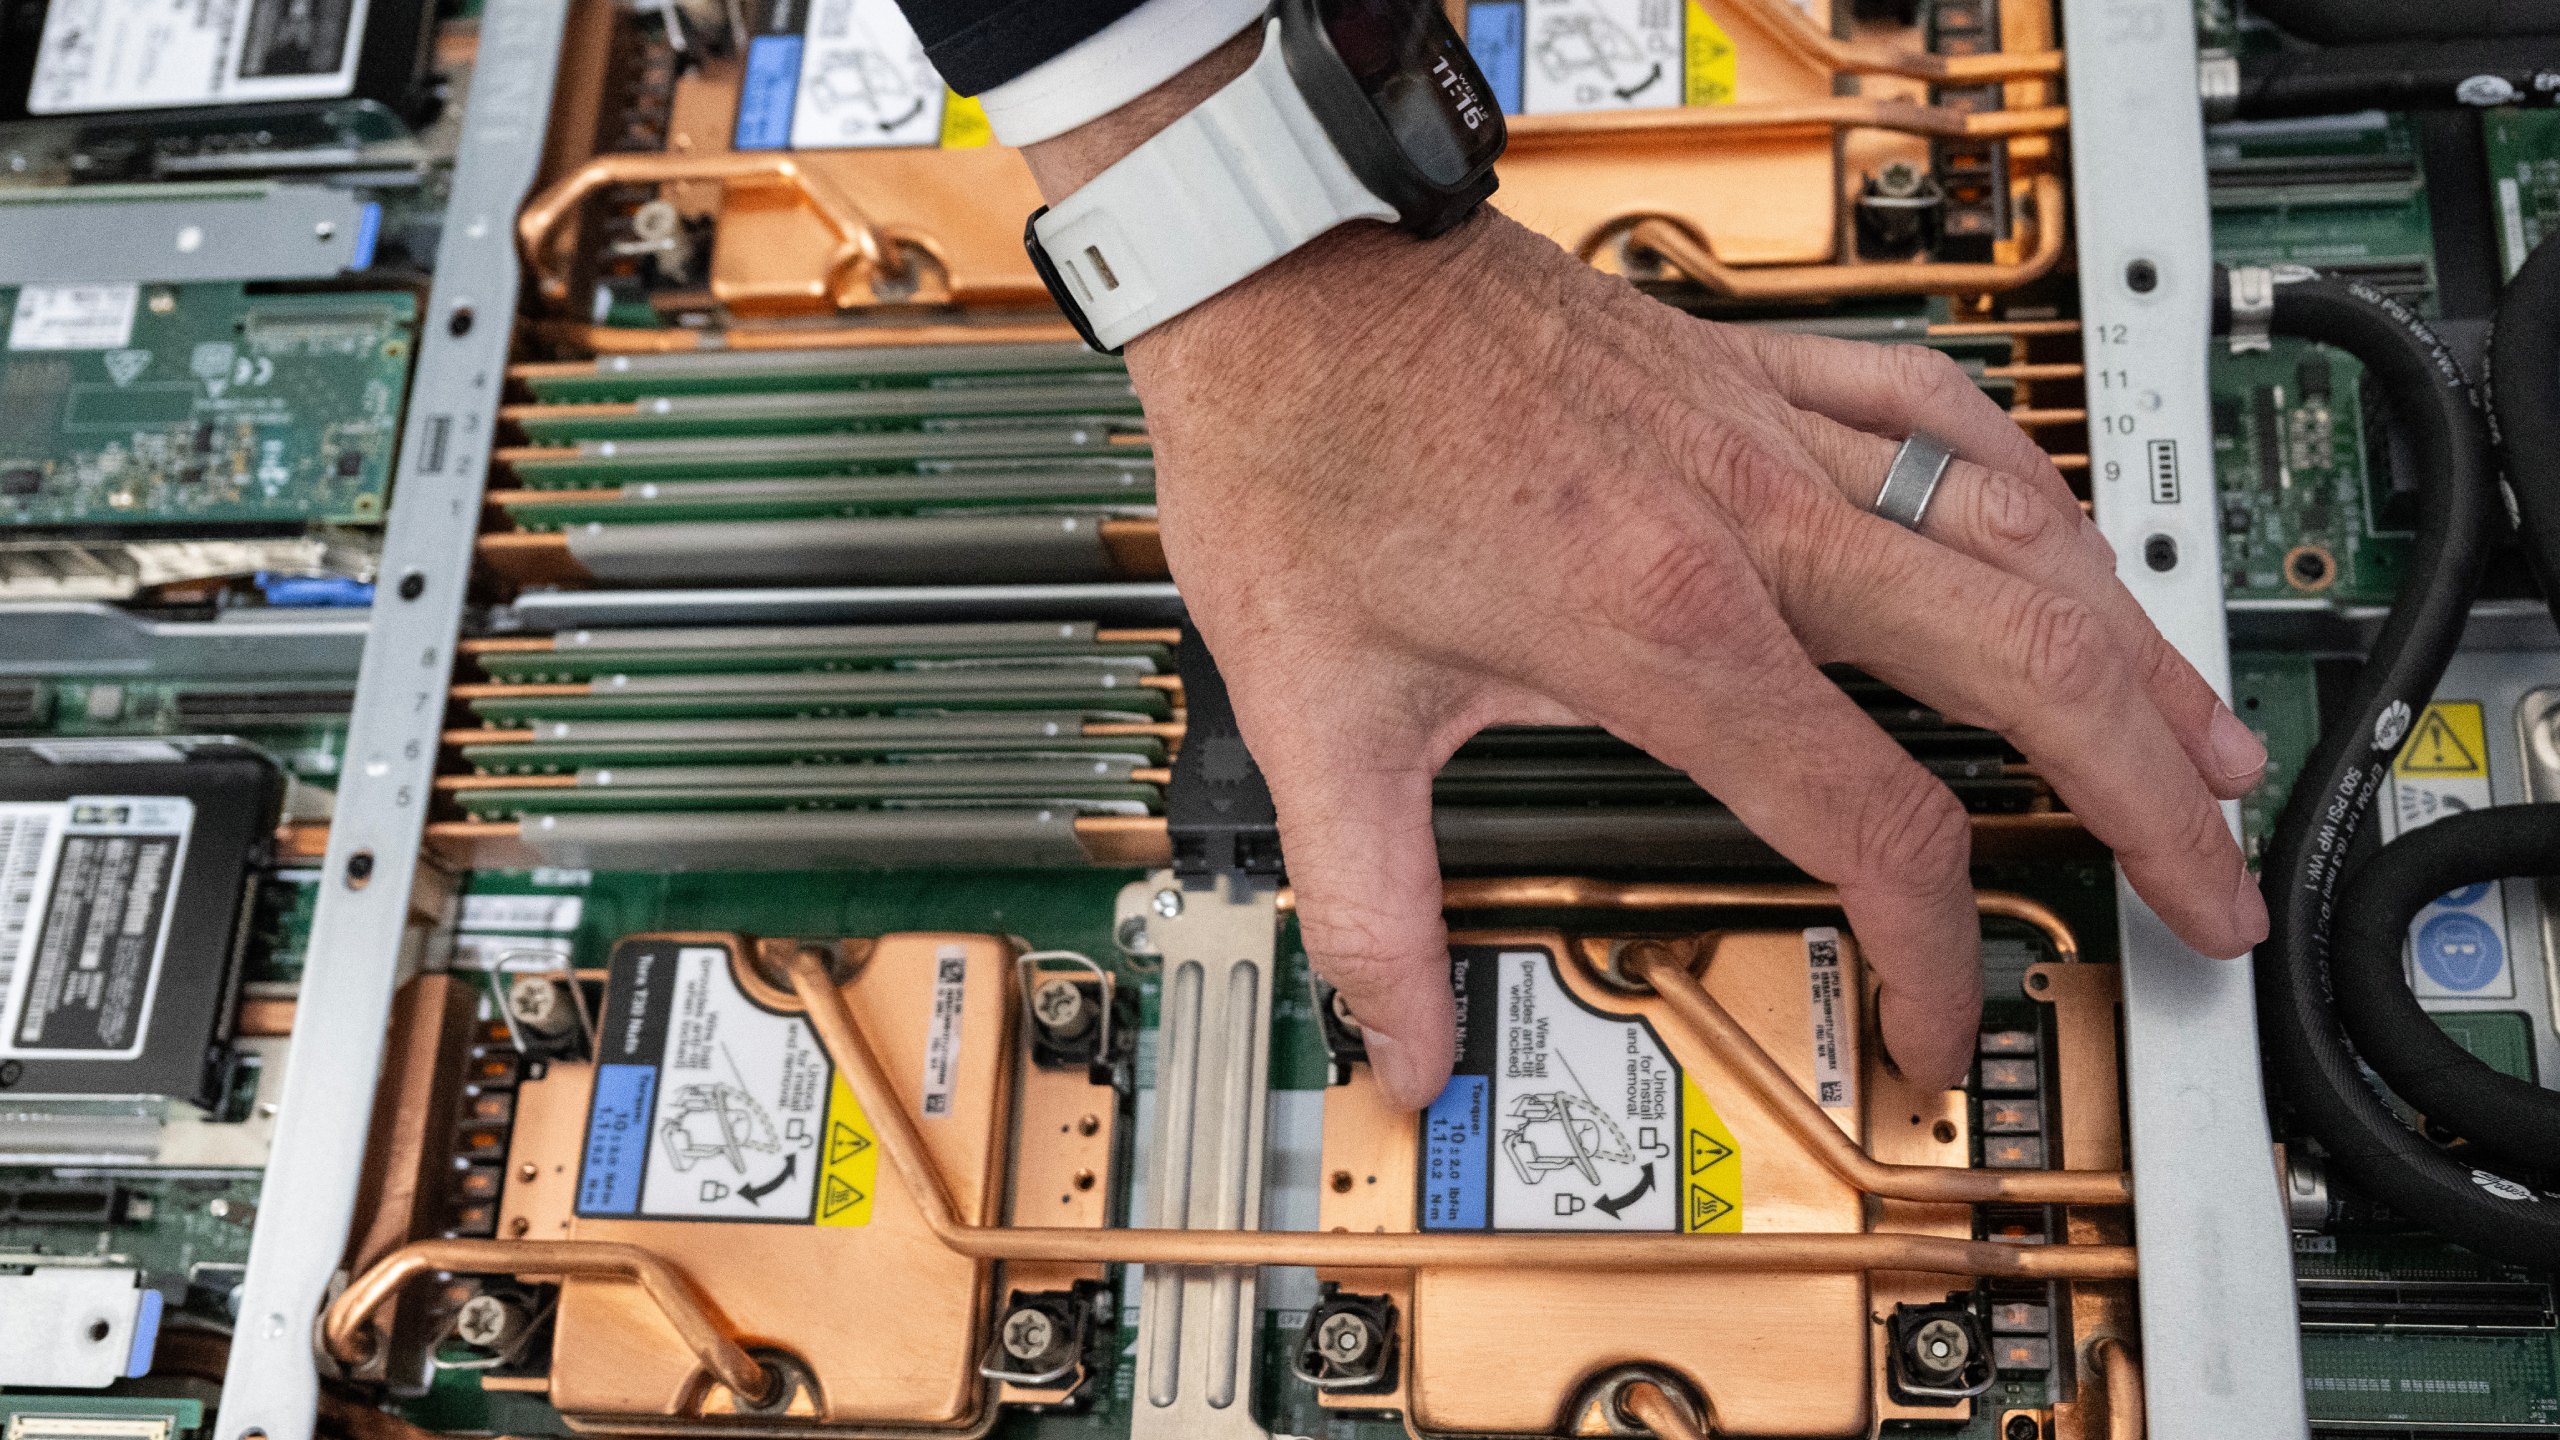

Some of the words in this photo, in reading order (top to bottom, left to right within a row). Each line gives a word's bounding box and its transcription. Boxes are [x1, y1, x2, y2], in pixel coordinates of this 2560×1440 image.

[1433, 56, 1484, 129] 11:15
[1459, 73, 1478, 102] WED
[2097, 323, 2128, 345] 12
[2100, 369, 2128, 389] 11
[2103, 413, 2135, 435] 10
[2104, 460, 2121, 482] 9
[414, 691, 430, 712] 7
[404, 738, 421, 761] 6
[2340, 766, 2362, 795] 500
[2356, 763, 2384, 810] EPDM
[397, 785, 411, 808] 5
[2327, 795, 2349, 825] PSI
[2318, 824, 2337, 851] WP
[1454, 958, 1470, 991] Torx
[1510, 984, 1521, 1022] when
[1521, 960, 1536, 1024] (provides
[1455, 994, 1469, 1023] T30
[1536, 1016, 1549, 1049] Wire
[1626, 1027, 1640, 1055] and
[1506, 1026, 1522, 1078] locked)
[1522, 1028, 1535, 1078] anti-tilt
[1535, 1052, 1549, 1078] bail
[1641, 1055, 1654, 1075] for
[1626, 1058, 1640, 1120] removal.
[1640, 1078, 1654, 1120] install
[1653, 1070, 1667, 1120] Unlock
[598, 1106, 613, 1129] 1.1
[613, 1112, 629, 1132] 10
[1471, 1082, 1483, 1136] Torque:
[1433, 1117, 1449, 1141] 1.1
[1450, 1122, 1466, 1144] 10
[1431, 1158, 1443, 1180] 0.2
[1449, 1158, 1460, 1180] 2.0
